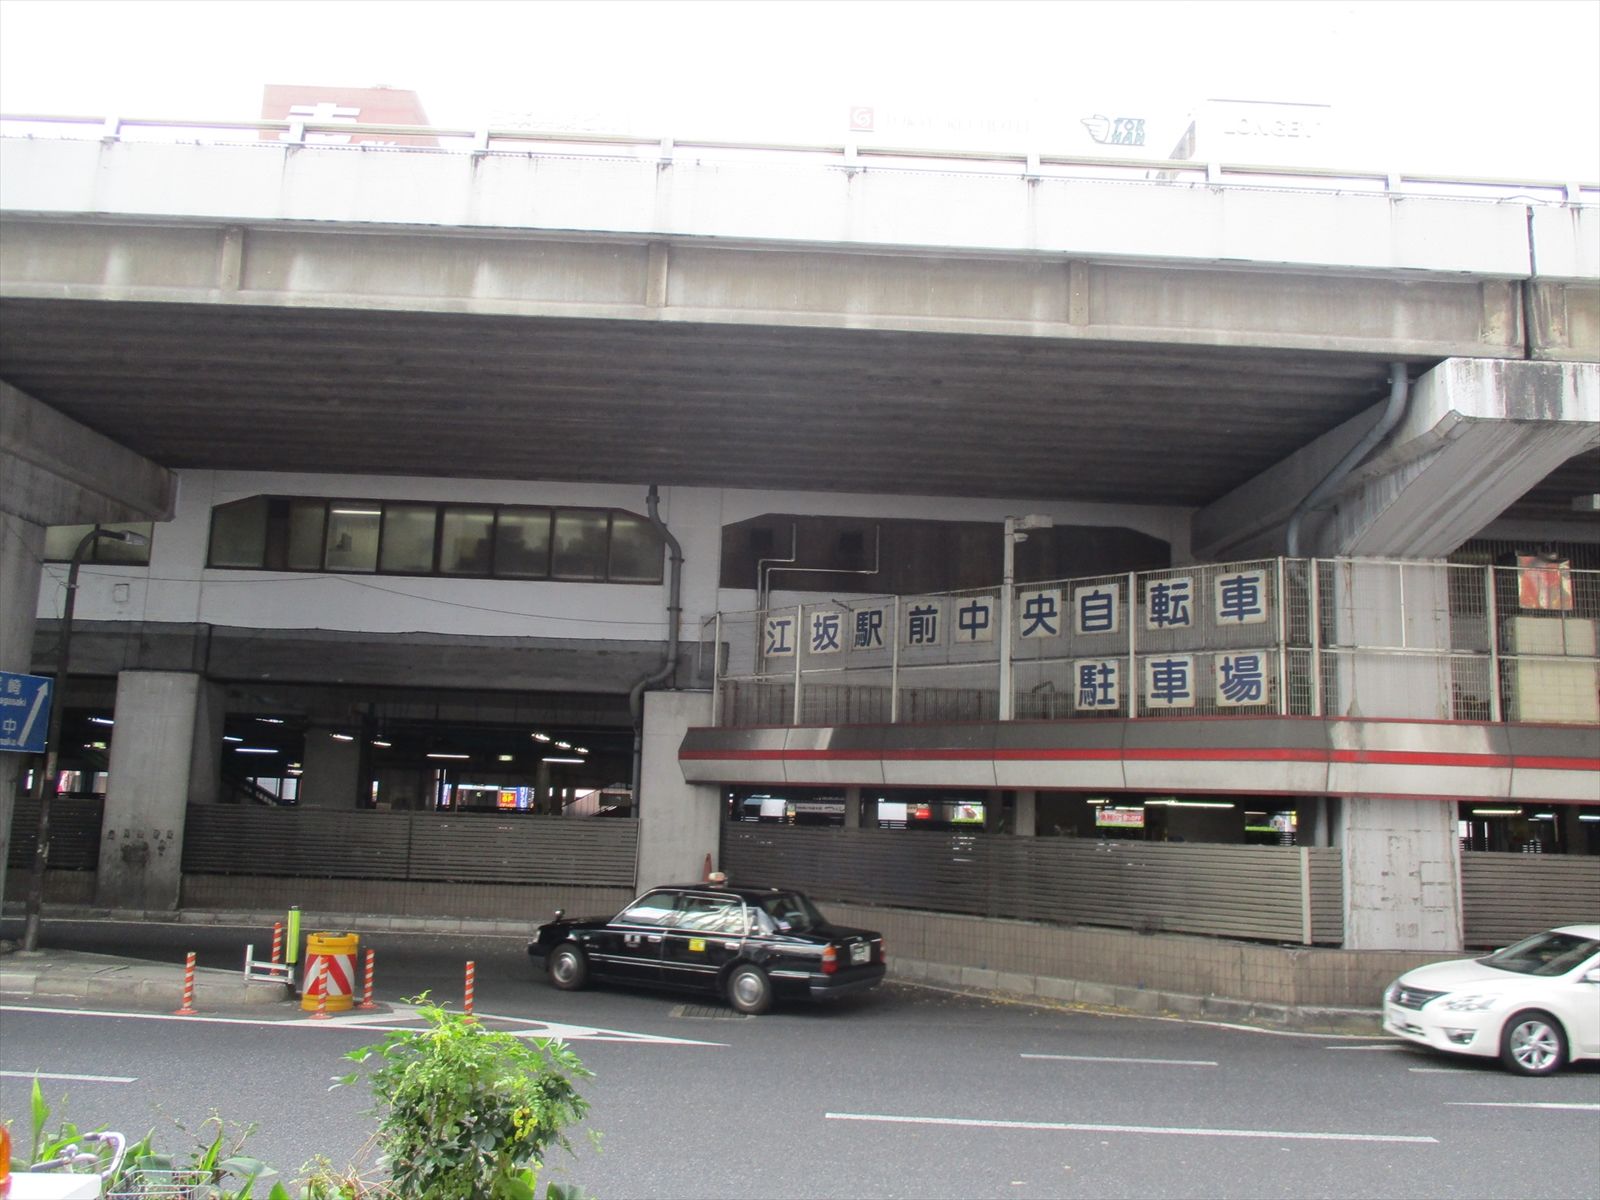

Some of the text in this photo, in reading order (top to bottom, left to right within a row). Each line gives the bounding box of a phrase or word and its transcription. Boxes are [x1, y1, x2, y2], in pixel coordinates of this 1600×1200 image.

[765, 576, 1261, 657] 江坂駅前中央自転車
[1079, 655, 1263, 706] 駐車場
